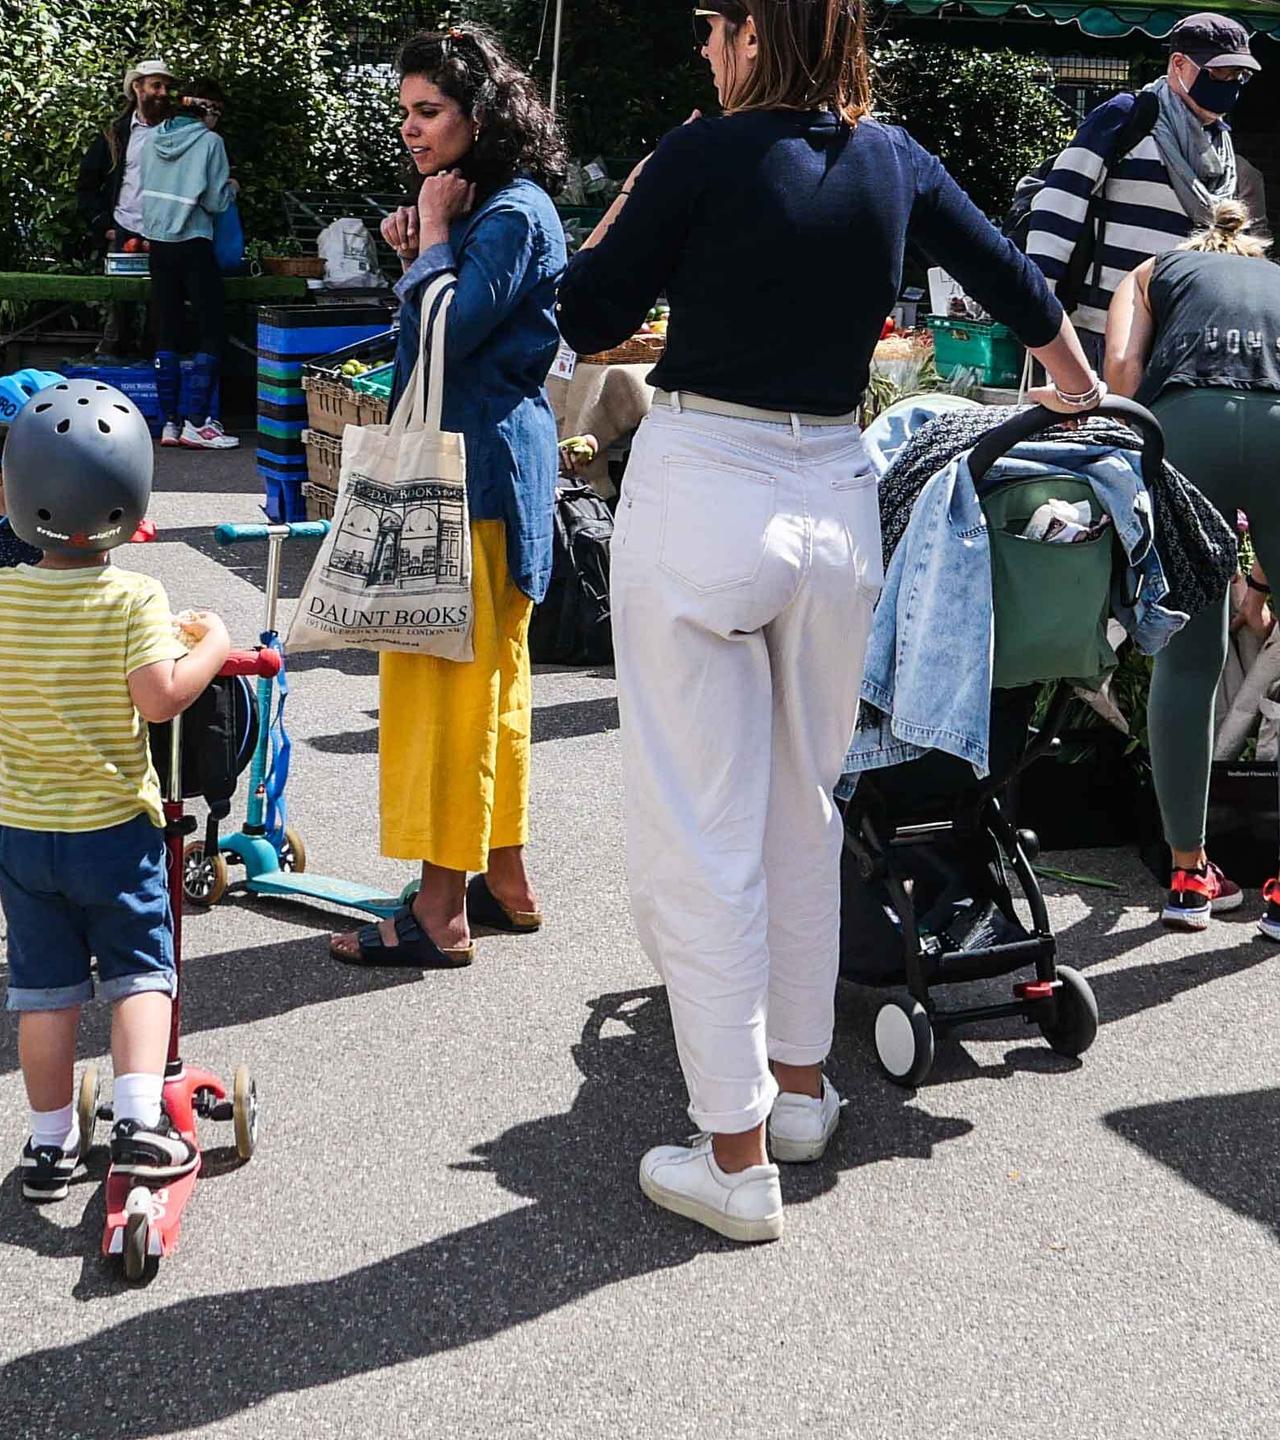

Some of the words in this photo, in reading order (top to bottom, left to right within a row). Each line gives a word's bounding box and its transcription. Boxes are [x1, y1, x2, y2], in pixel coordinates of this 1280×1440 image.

[310, 596, 390, 627] DAUNT
[394, 605, 469, 626] BOOKS
[406, 628, 445, 637] LONDON
